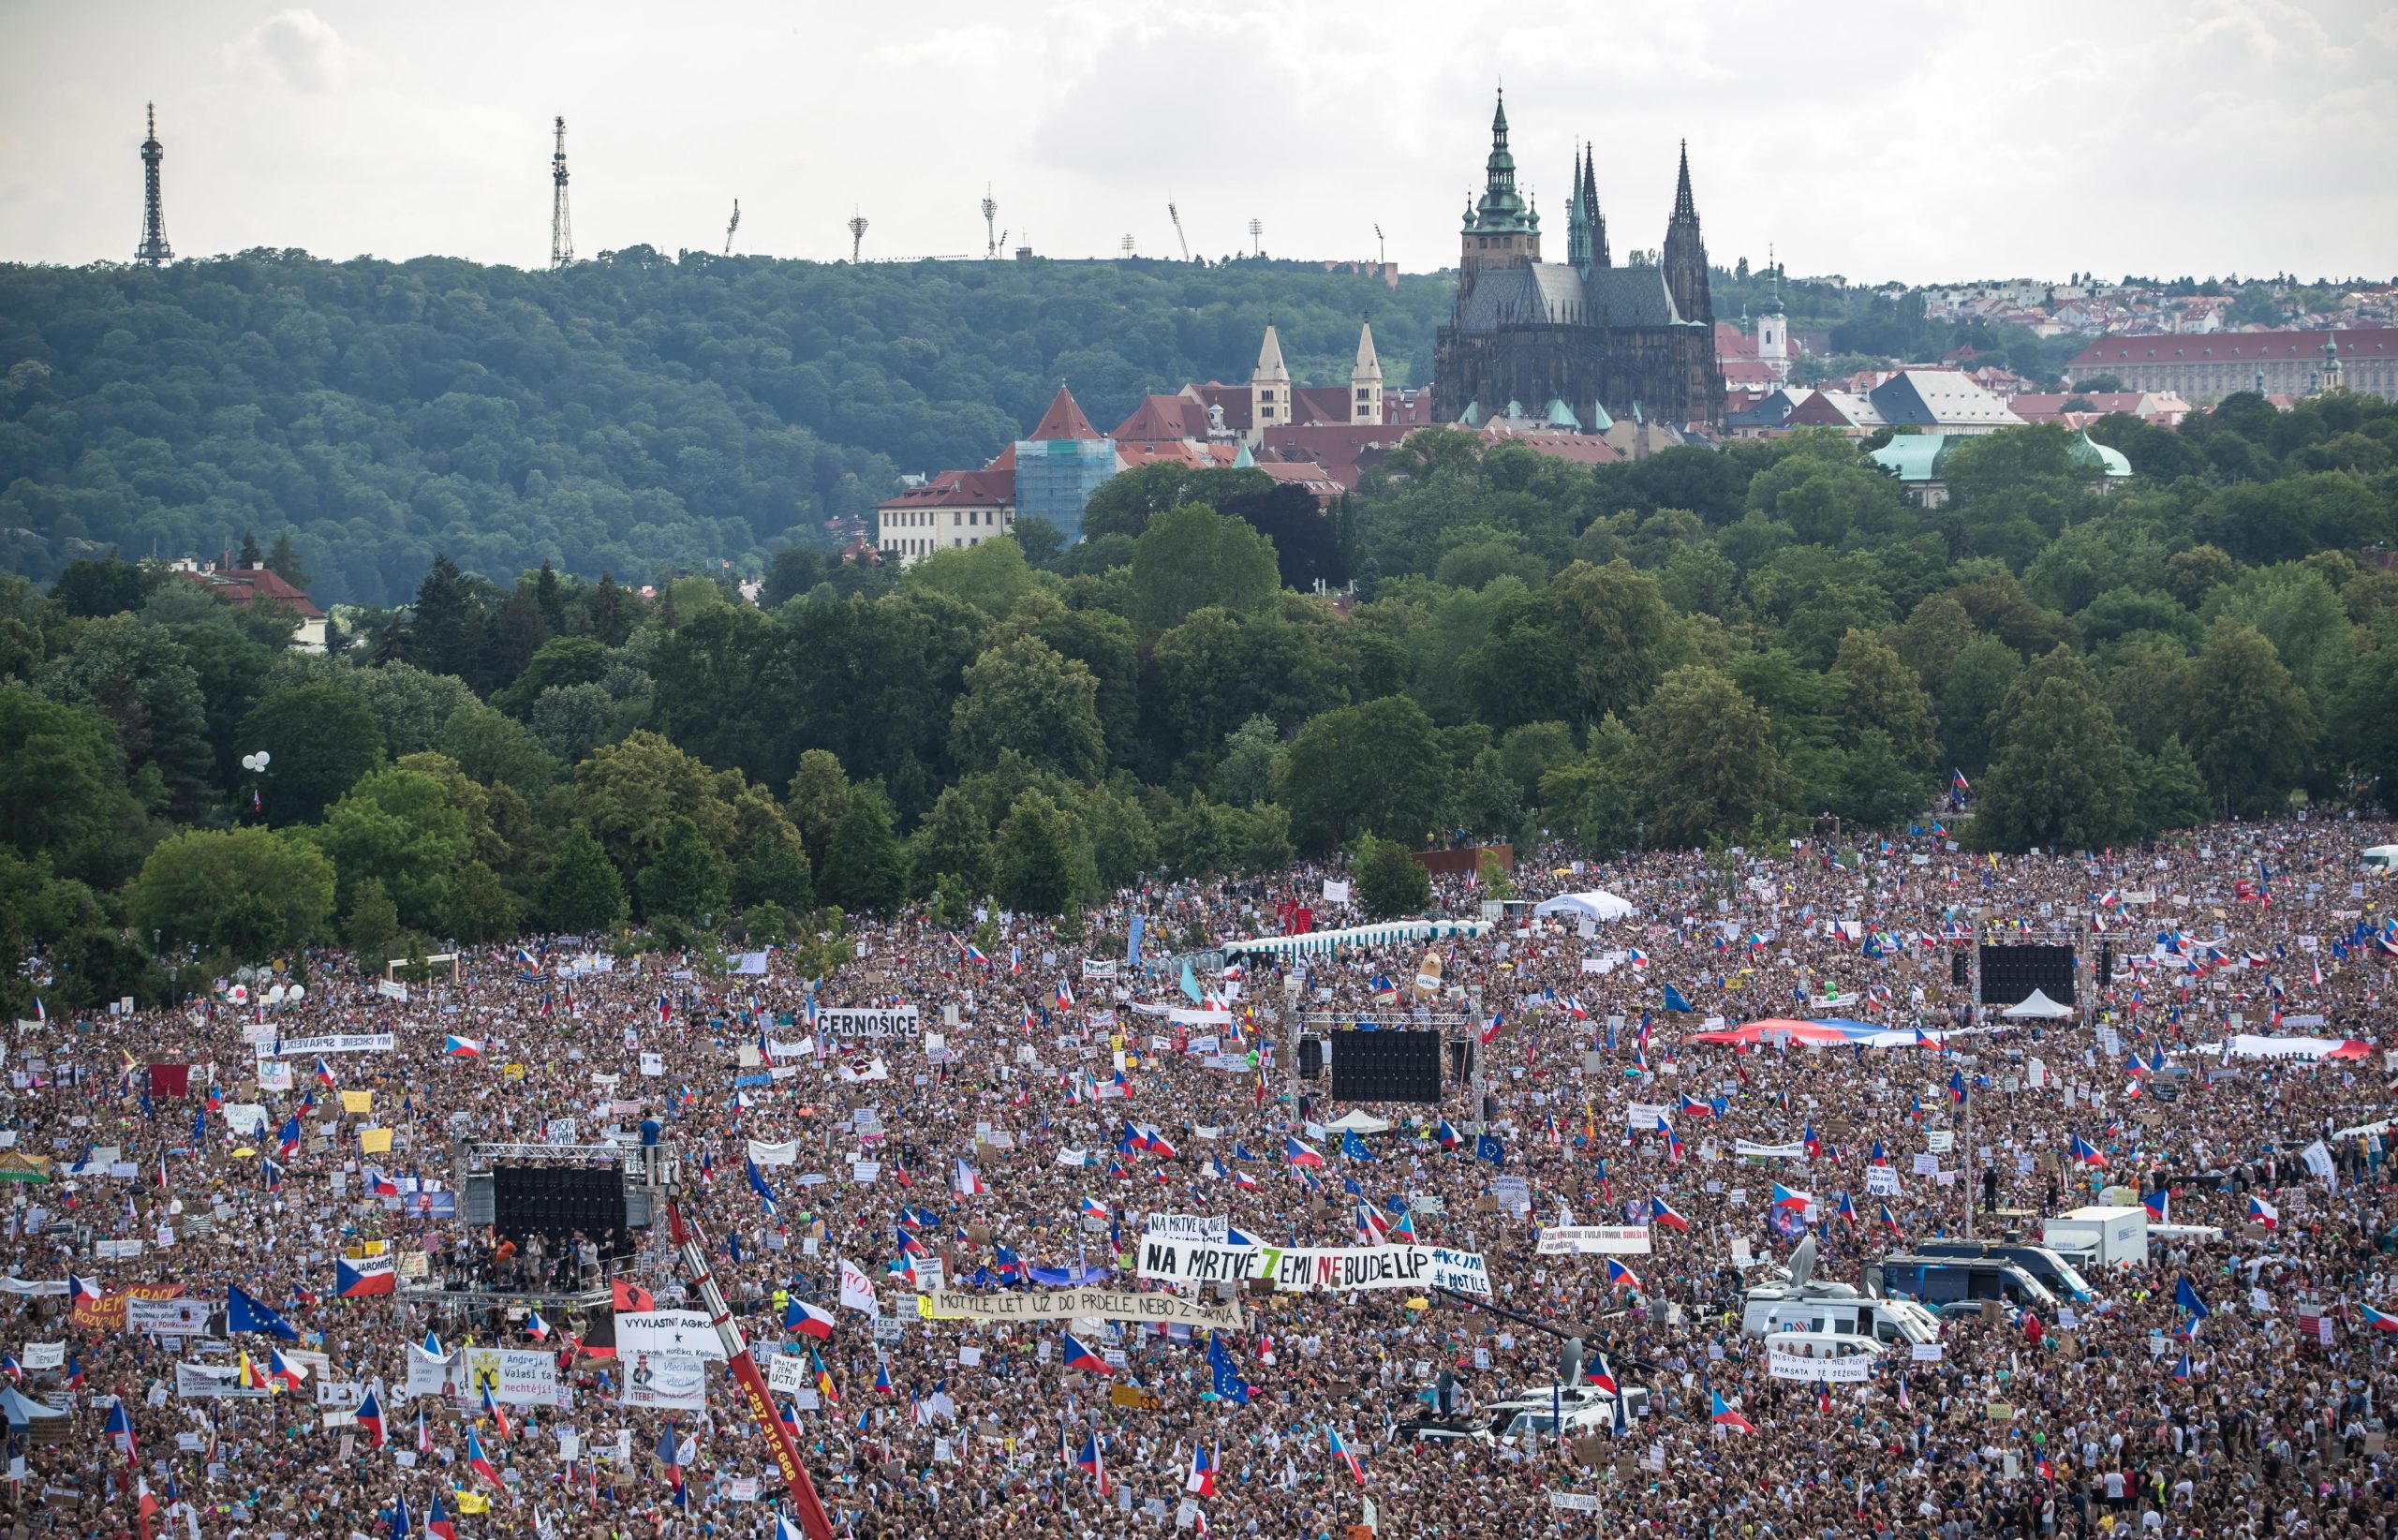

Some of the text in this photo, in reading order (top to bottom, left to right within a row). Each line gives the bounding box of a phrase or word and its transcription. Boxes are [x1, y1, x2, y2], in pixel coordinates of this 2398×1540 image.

[817, 1010, 918, 1035] ČERNOŠICE
[1151, 1216, 1166, 1231] NA
[1147, 1243, 1177, 1274] NA
[1186, 1246, 1259, 1281] MRTVÉ
[1261, 1248, 1311, 1286] ZEMI
[1394, 1246, 1428, 1280] LÍP
[999, 1295, 1024, 1312] LEŤ
[1032, 1294, 1051, 1311] UŽ
[1058, 1295, 1075, 1311] DO
[1082, 1295, 1134, 1315] PRDELE,
[1139, 1298, 1175, 1315] NEBO
[1180, 1303, 1192, 1317] Z
[626, 1317, 714, 1328] VYVLASTNIT AGRO
[504, 1369, 536, 1379] Valaši
[1774, 1366, 1809, 1376] PRASATA
[634, 1392, 654, 1402] TEBE!
[749, 1392, 796, 1481] 257 312 666
